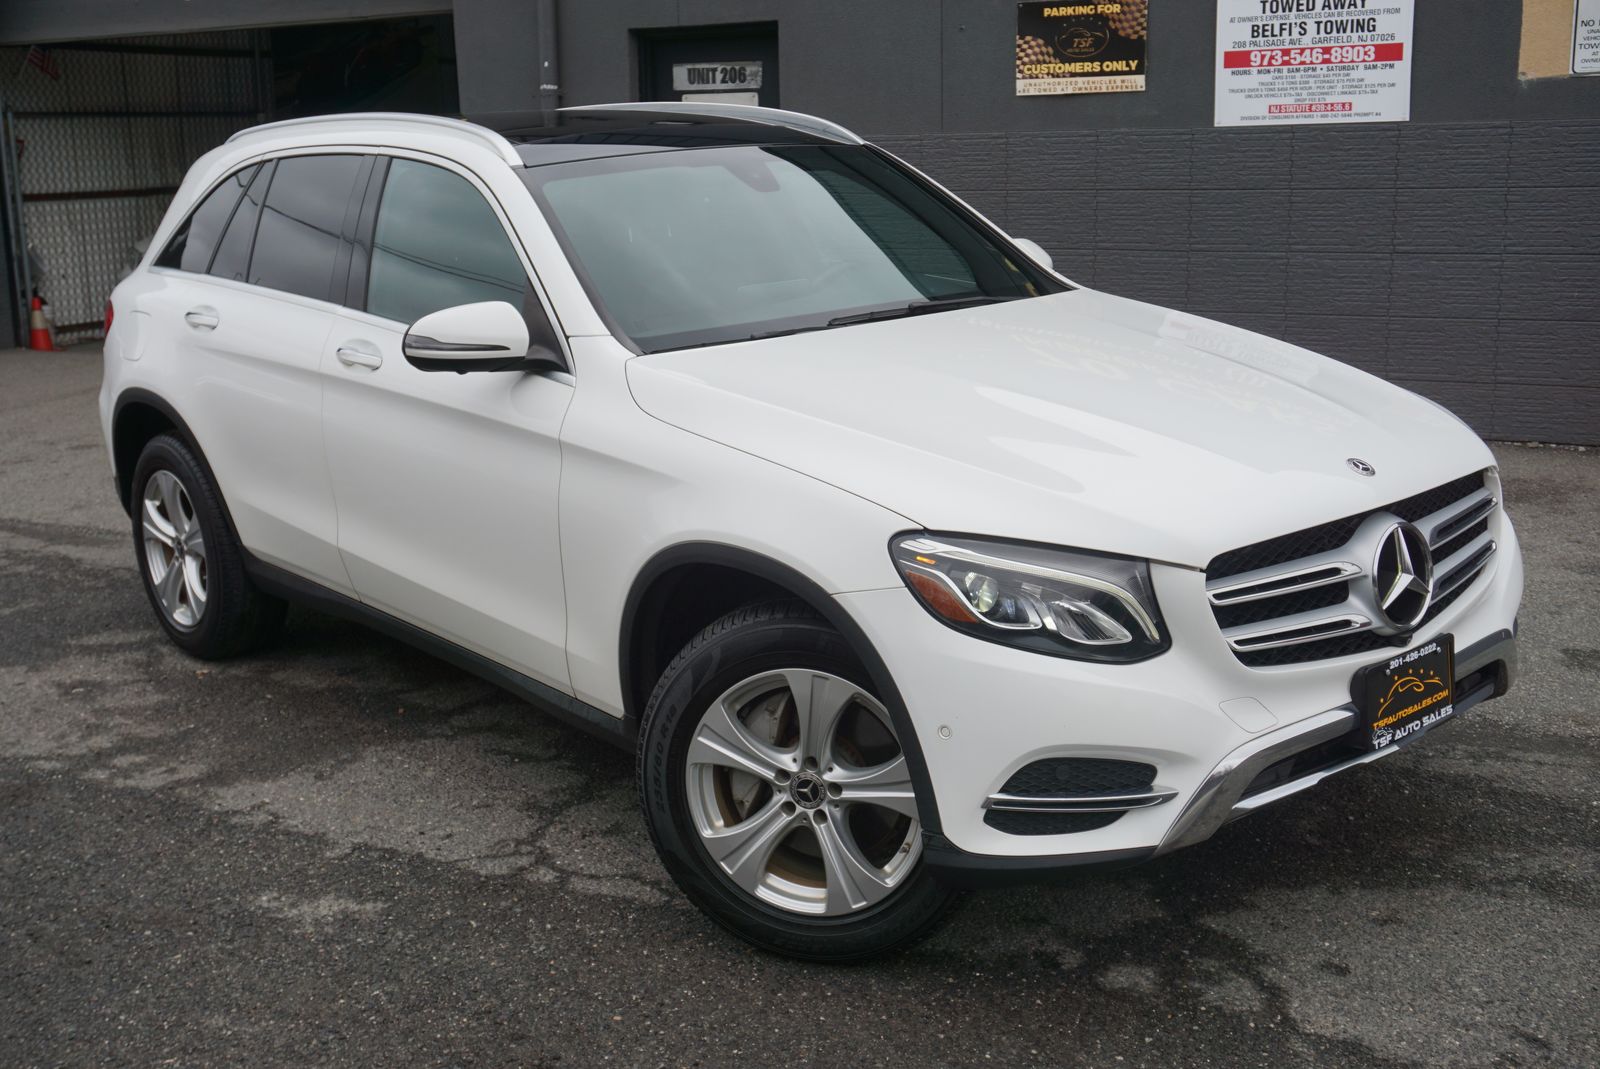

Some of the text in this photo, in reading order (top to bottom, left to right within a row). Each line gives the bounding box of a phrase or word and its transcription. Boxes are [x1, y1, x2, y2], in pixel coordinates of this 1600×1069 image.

[1043, 4, 1121, 17] PARKING FOR
[1260, 0, 1366, 14] TOWED AWAY
[1294, 12, 1322, 20] VEHICLES
[1346, 9, 1382, 17] RECOVERED
[1251, 17, 1377, 38] BELFI'S TOWING
[1581, 19, 1595, 27] NO
[1232, 40, 1247, 48] 208
[1249, 38, 1286, 47] PALISADE
[1357, 34, 1369, 43] NJ
[1370, 33, 1396, 42] 07026
[1250, 46, 1376, 66] 973-546-8903
[1023, 59, 1138, 74] CUSTOMERS ONLY
[1257, 67, 1283, 75] MON-FRI
[687, 66, 748, 85] UNIT 206
[1024, 80, 1078, 88] UNAUTHORIZED
[1082, 78, 1117, 86] VEHICLES
[1281, 104, 1311, 112] STATUTE
[1390, 643, 1437, 669] 201-426-0222
[1372, 689, 1449, 730] TSFAUTOSALES.COM
[1373, 704, 1453, 749] TSF AUTO SALES
